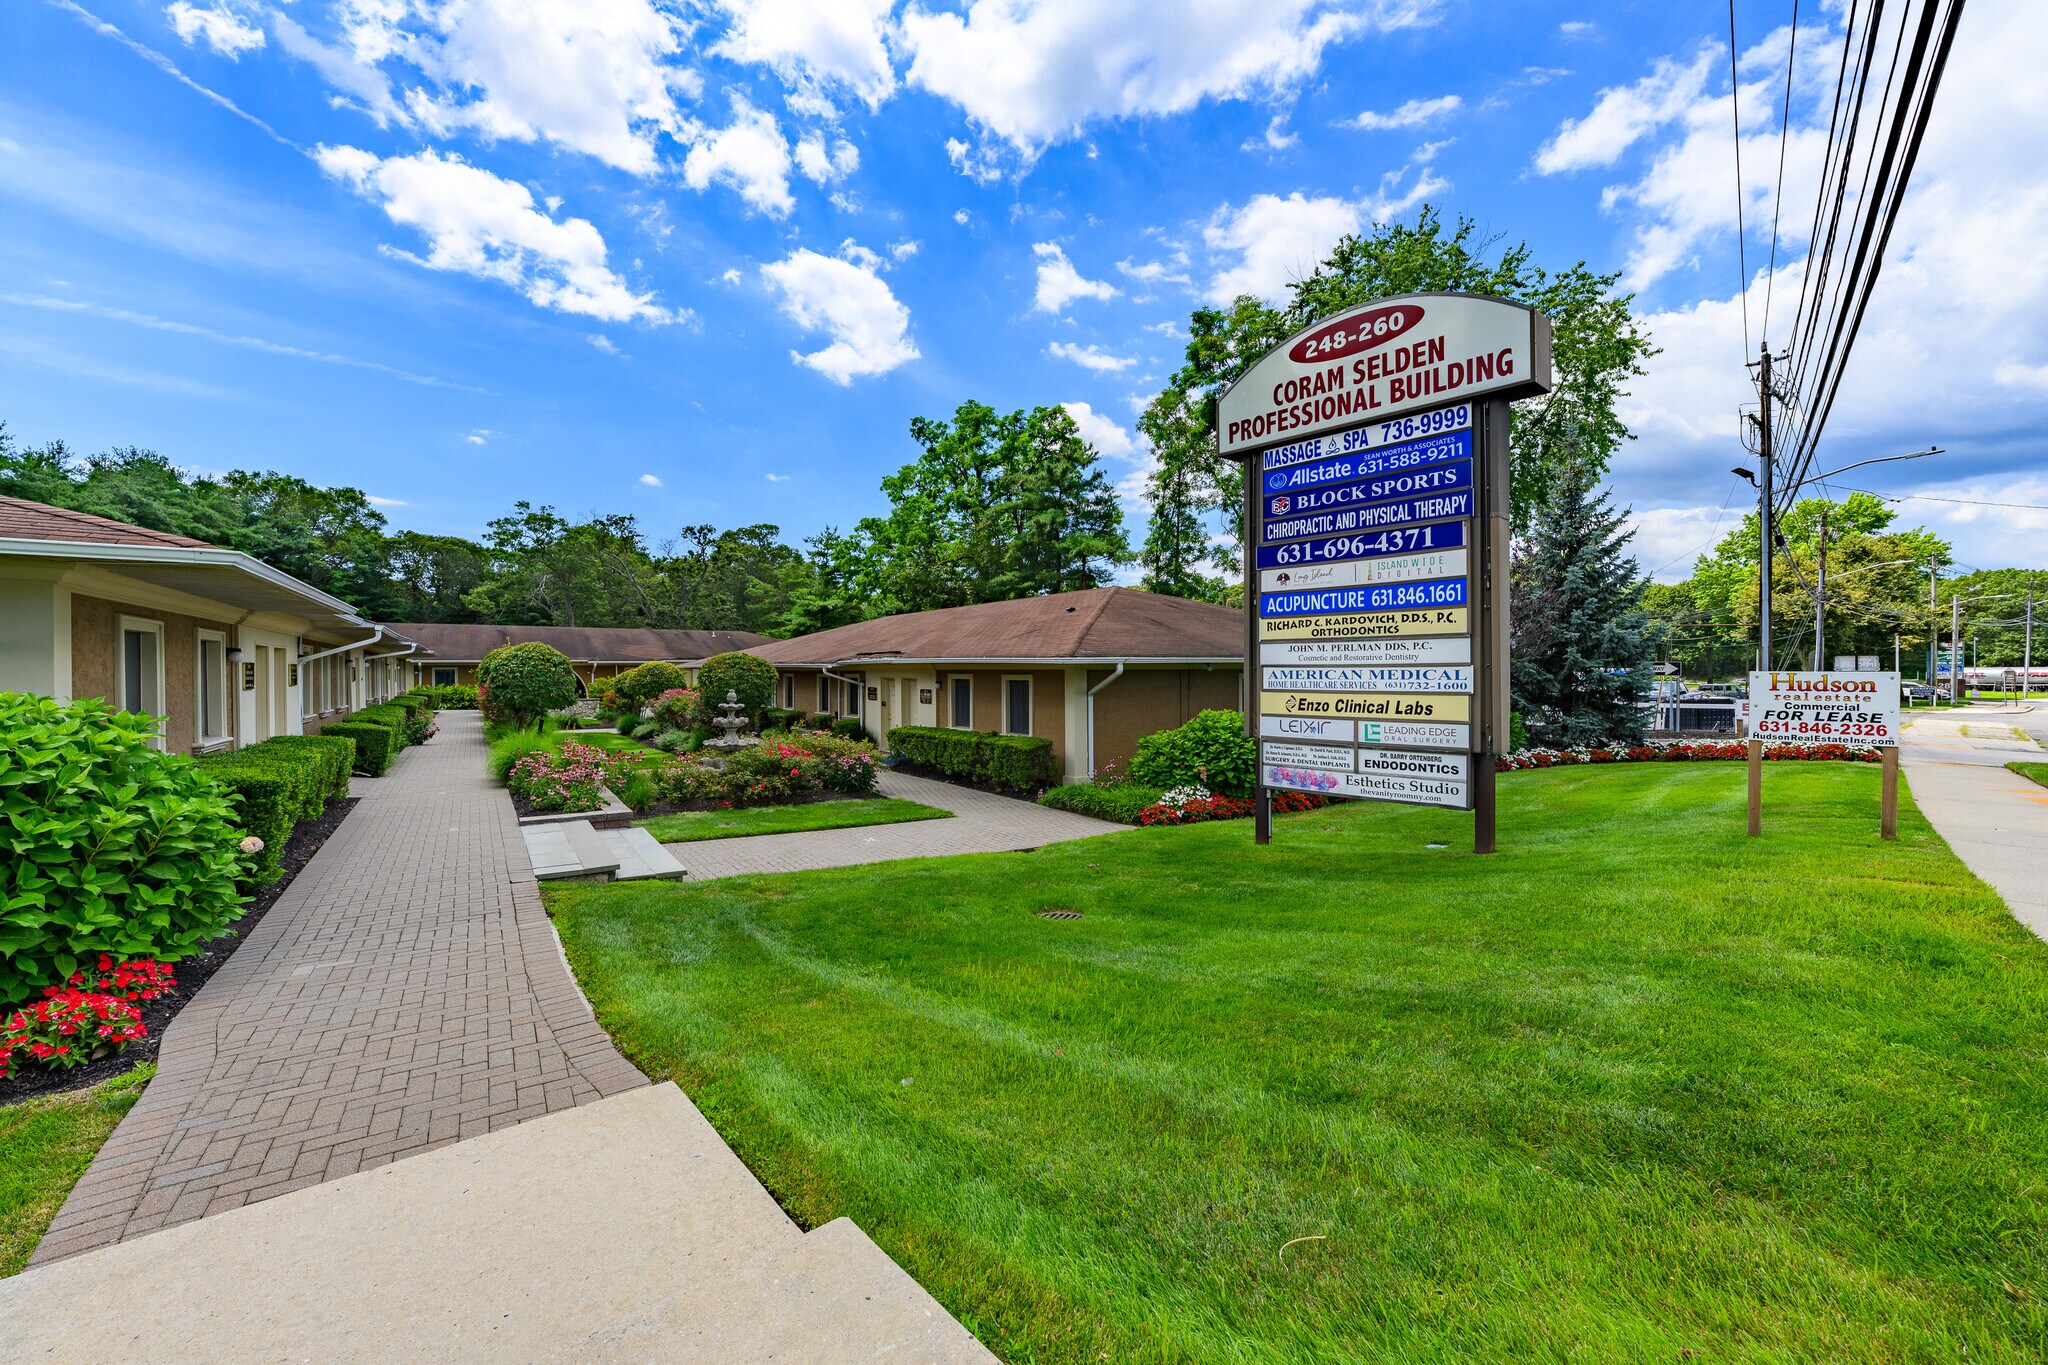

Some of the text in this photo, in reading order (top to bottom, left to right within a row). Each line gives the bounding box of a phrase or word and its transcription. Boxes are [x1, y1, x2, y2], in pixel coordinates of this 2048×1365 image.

[1305, 312, 1404, 358] 248-260
[1273, 336, 1444, 405] CORAM SELDEN
[1229, 348, 1513, 443] PROFESSIONAL BUILDING
[1264, 406, 1468, 468] MASSAGE SPA 736-9999
[1364, 451, 1380, 460] SEAN
[1381, 447, 1406, 456] WORTH
[1414, 437, 1455, 449] ASSOCIATES
[1289, 443, 1463, 486] Allstate 631-588-9211
[1297, 469, 1456, 509] BLOCK SPORTS
[1267, 495, 1467, 540] CHIROPRACTIC AND PHYSICAL THERAPY
[1277, 527, 1434, 564] 631-696-4371
[1294, 568, 1333, 582] Long Island
[1378, 566, 1444, 579] DIGITAL
[1267, 584, 1461, 612] ACUPUNCTURE 631.846.1661
[1267, 612, 1456, 632] RICHARD C. KARDOVICH, D.D.S., P.C.
[1312, 625, 1399, 637] ORTHODONTICS
[1317, 644, 1328, 652] M.
[1331, 643, 1381, 652] PERLMAN
[1385, 643, 1409, 651] DDS,
[1413, 642, 1432, 650] P.C.
[1385, 653, 1419, 661] Dentistry
[1268, 670, 1467, 680] AMERICAN MEDICAL
[1769, 673, 1877, 692] Hudson
[1290, 681, 1338, 689] HEALTHCARE
[1774, 693, 1809, 701] real
[1298, 698, 1433, 716] Enzo Clinical Labs
[1785, 702, 1859, 711] Commercial
[1764, 711, 1883, 723] FOR LEASE
[1384, 726, 1456, 737] LEADING EDGE
[1759, 721, 1887, 736] 631-846-2326
[1753, 733, 1894, 745] HudsonRealEstateInc.com
[1365, 760, 1459, 775] ENDODONTICS
[1346, 775, 1459, 795] Esthetics Studio
[1360, 788, 1441, 802] thevanityroomny.com
